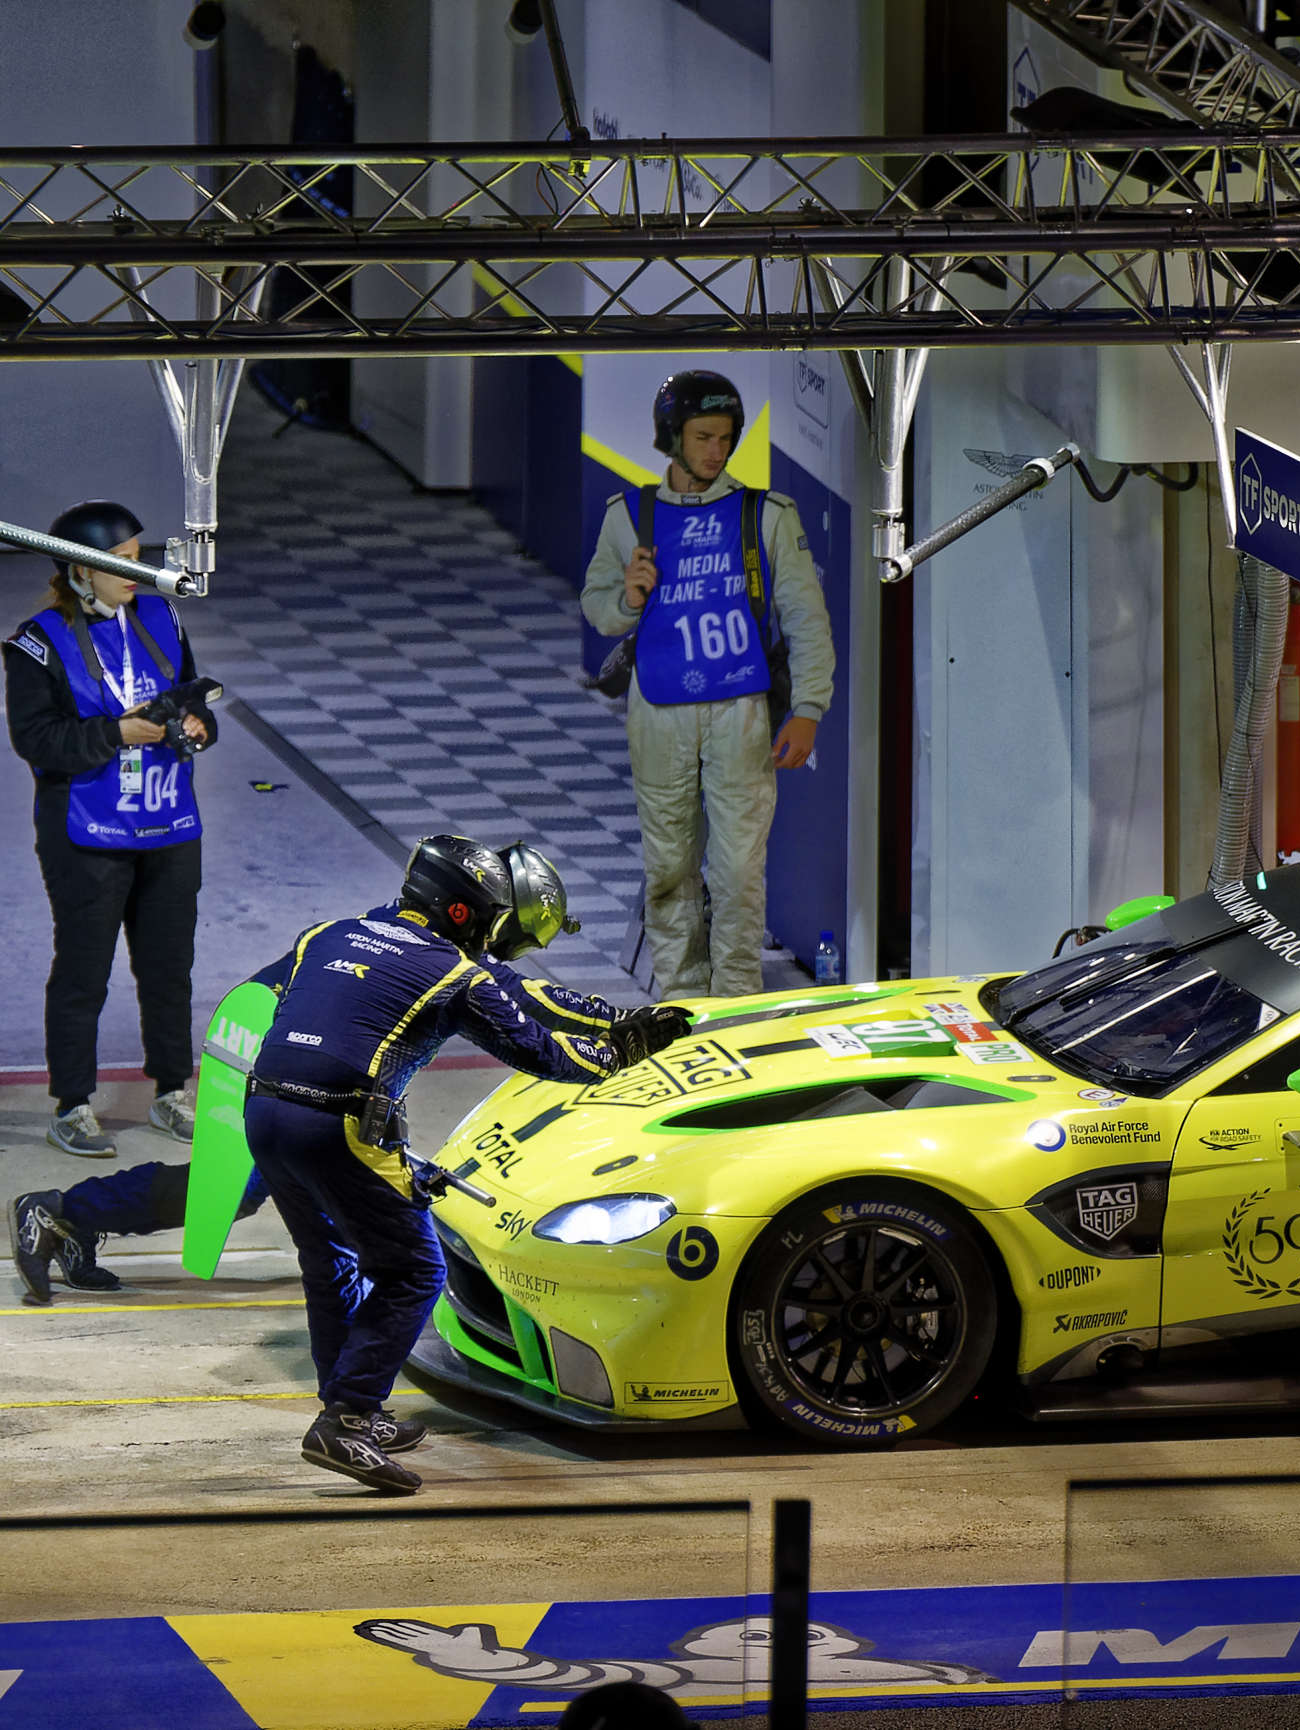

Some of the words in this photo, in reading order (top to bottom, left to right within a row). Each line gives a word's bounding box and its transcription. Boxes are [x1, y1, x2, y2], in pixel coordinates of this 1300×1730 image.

[1243, 474, 1259, 510] TF
[683, 513, 723, 538] 24h
[678, 552, 730, 579] MEDIA
[674, 609, 749, 661] 160
[345, 932, 371, 944] ASTON
[369, 938, 404, 956] MARTIN
[351, 942, 383, 955] RACING
[327, 959, 371, 979] AMR
[286, 1031, 323, 1046] sparco
[850, 1019, 952, 1044] 97
[665, 1045, 733, 1085] TAG
[970, 1044, 1023, 1062] PRO
[1069, 1122, 1096, 1135] Royal
[1101, 1121, 1116, 1132] Air
[1118, 1120, 1149, 1132] Force
[1071, 1133, 1132, 1145] Benevolent
[1133, 1132, 1161, 1144] Fund
[1222, 1128, 1249, 1136] ACTION
[471, 1122, 523, 1178] TOTAL
[1082, 1187, 1132, 1208] TAG
[495, 1209, 533, 1241] sky
[859, 1202, 948, 1236] MICHELIN
[1083, 1207, 1133, 1236] HEUER
[498, 1264, 560, 1297] HACKETT
[1047, 1266, 1094, 1289] DUPONT
[512, 1288, 540, 1303] LONDON
[653, 1388, 720, 1398] MICHELIN
[792, 1403, 880, 1436] MICHELIN
